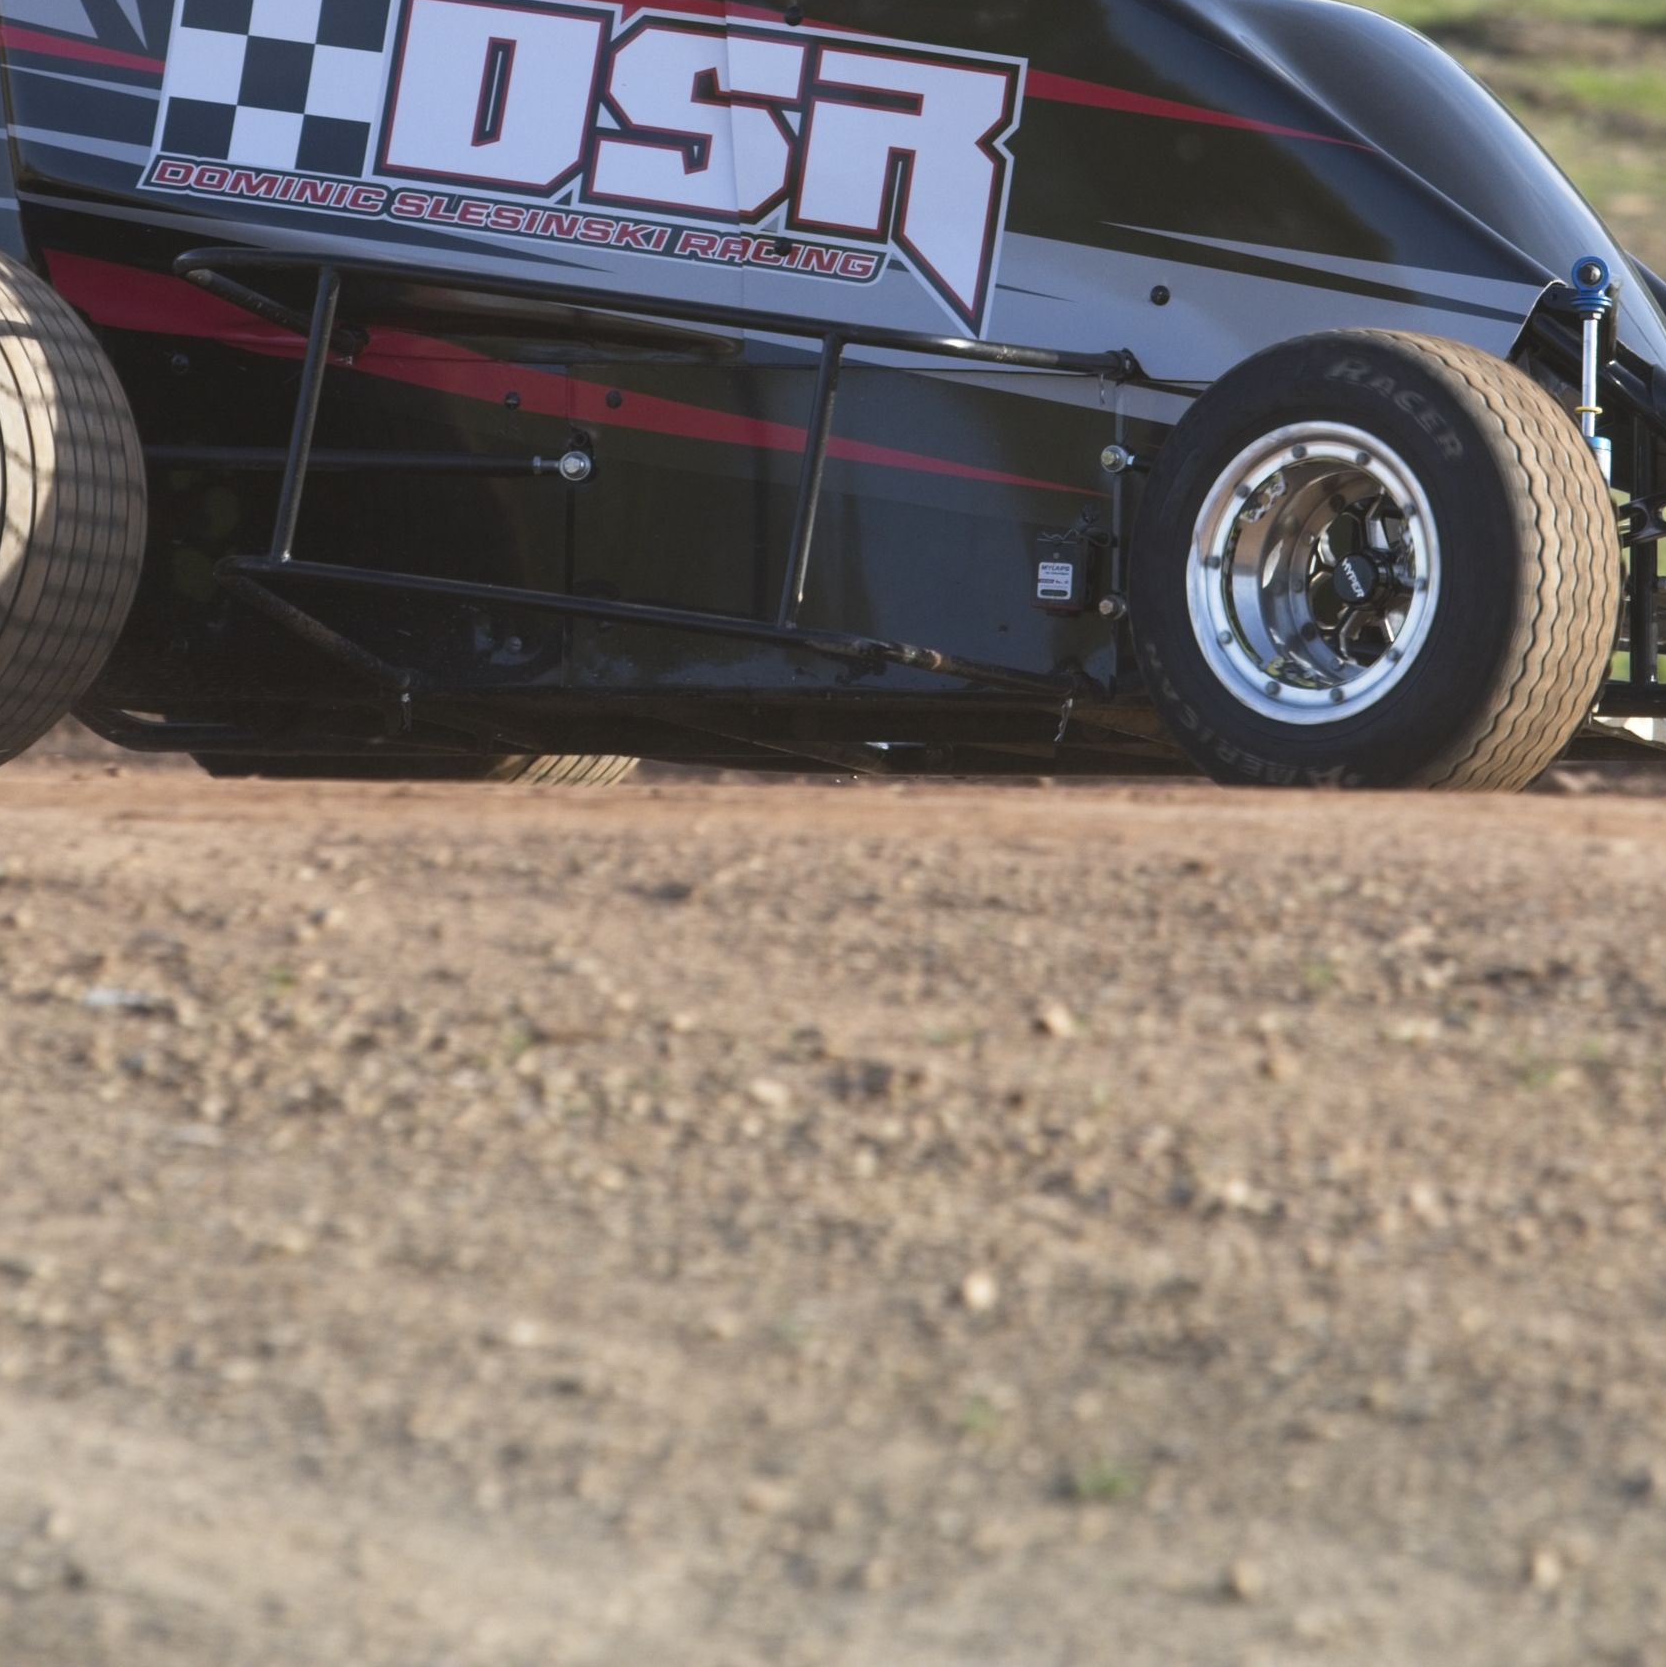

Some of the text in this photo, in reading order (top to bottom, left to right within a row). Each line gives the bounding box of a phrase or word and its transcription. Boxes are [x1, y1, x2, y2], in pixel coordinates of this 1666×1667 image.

[150, 159, 880, 279] DOMINIC SLESINSKI RACING
[1325, 359, 1463, 460] RACER
[1342, 557, 1365, 598] HYPER
